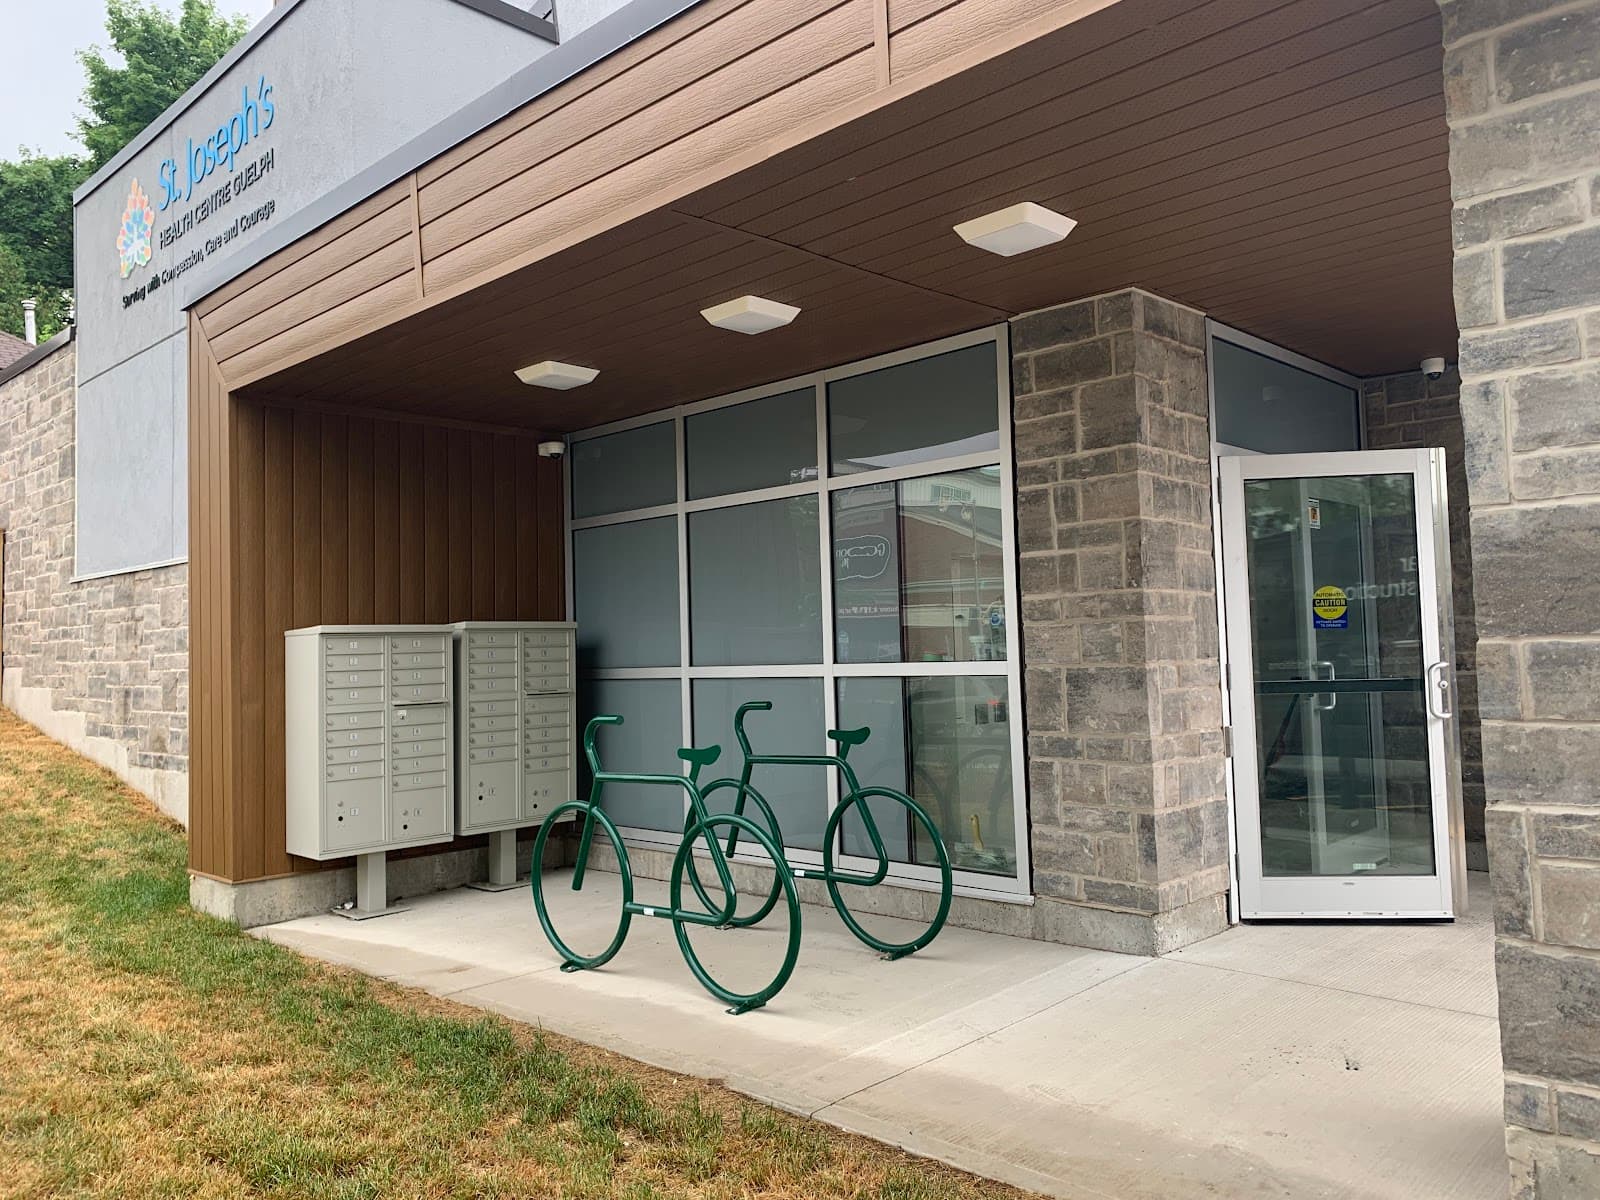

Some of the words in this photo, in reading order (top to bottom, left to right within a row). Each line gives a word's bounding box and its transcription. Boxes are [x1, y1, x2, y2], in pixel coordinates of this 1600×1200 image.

[158, 158, 181, 211] St.
[185, 75, 275, 201] Joseph's
[159, 212, 194, 250] HEALTH
[195, 180, 231, 224] CENTRE
[233, 148, 275, 196] GUELPH
[122, 280, 146, 309] Serving
[147, 274, 161, 295] with
[205, 233, 222, 255] Care
[223, 220, 239, 242] and
[240, 199, 275, 232] Courage
[1315, 599, 1346, 607] CAUTION
